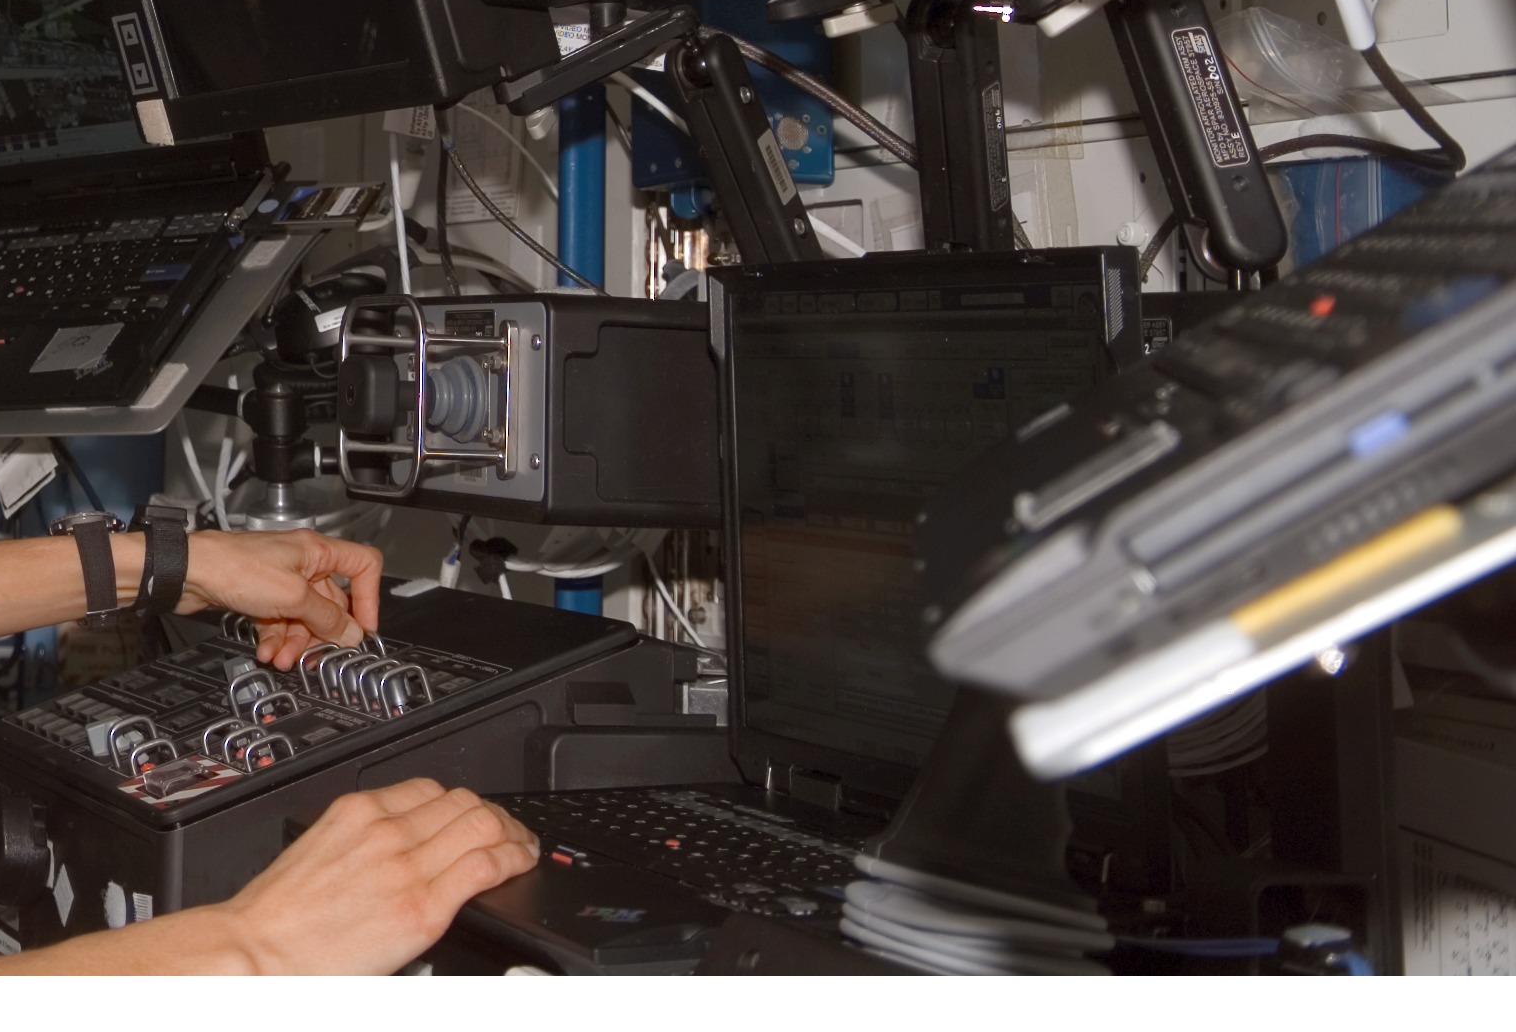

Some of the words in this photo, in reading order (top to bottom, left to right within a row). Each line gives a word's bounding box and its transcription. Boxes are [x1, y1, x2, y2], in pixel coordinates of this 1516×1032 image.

[1174, 35, 1186, 56] ASSY
[1182, 56, 1192, 74] ARM
[1190, 58, 1212, 108] AEROSPACE
[1213, 79, 1224, 94] S/N
[1188, 74, 1210, 127] ARTICULATED
[1207, 108, 1220, 131] SPAR
[1206, 126, 1222, 162] MONITOR
[1215, 130, 1225, 141] by
[1230, 131, 1240, 140] E
[1219, 142, 1230, 160] MFD
[1225, 136, 1238, 159] ASSY
